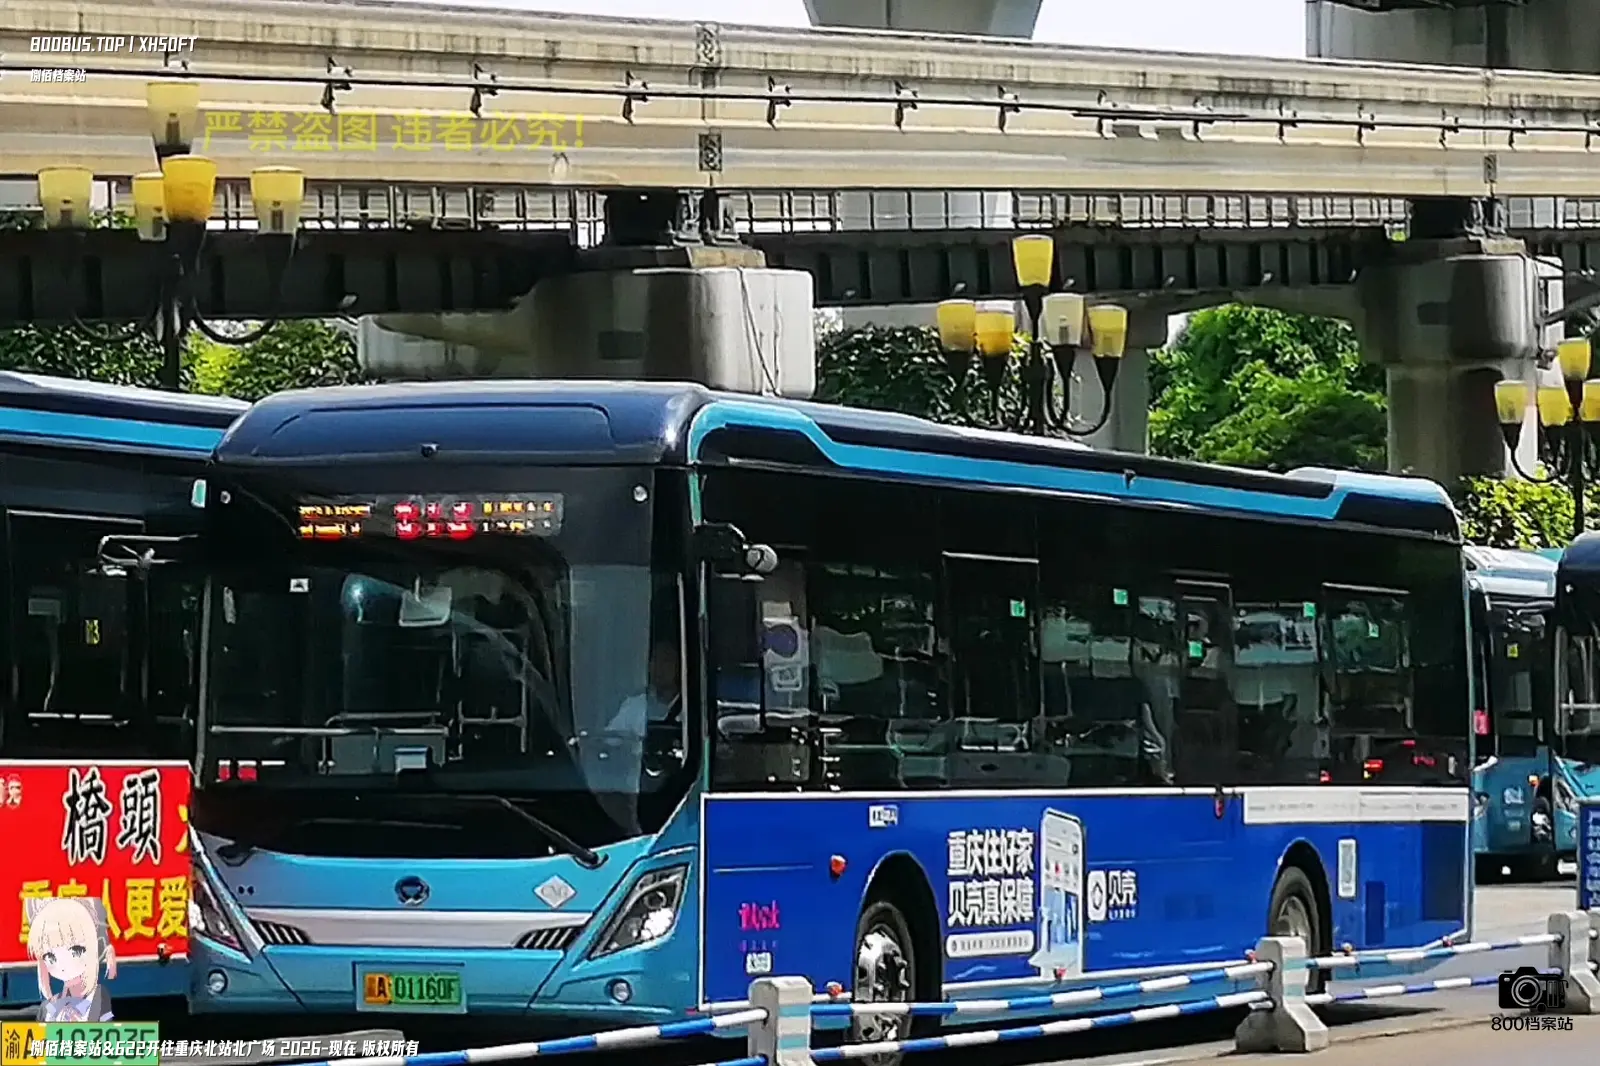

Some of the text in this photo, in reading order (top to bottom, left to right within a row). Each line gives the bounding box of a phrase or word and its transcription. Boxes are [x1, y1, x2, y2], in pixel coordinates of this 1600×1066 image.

[62, 766, 162, 867] 橋頭
[947, 828, 1035, 876] 重庆住好家
[20, 876, 189, 944] 人更爱
[947, 877, 1035, 927] 贝壳真保障
[1108, 870, 1138, 906] 贝壳
